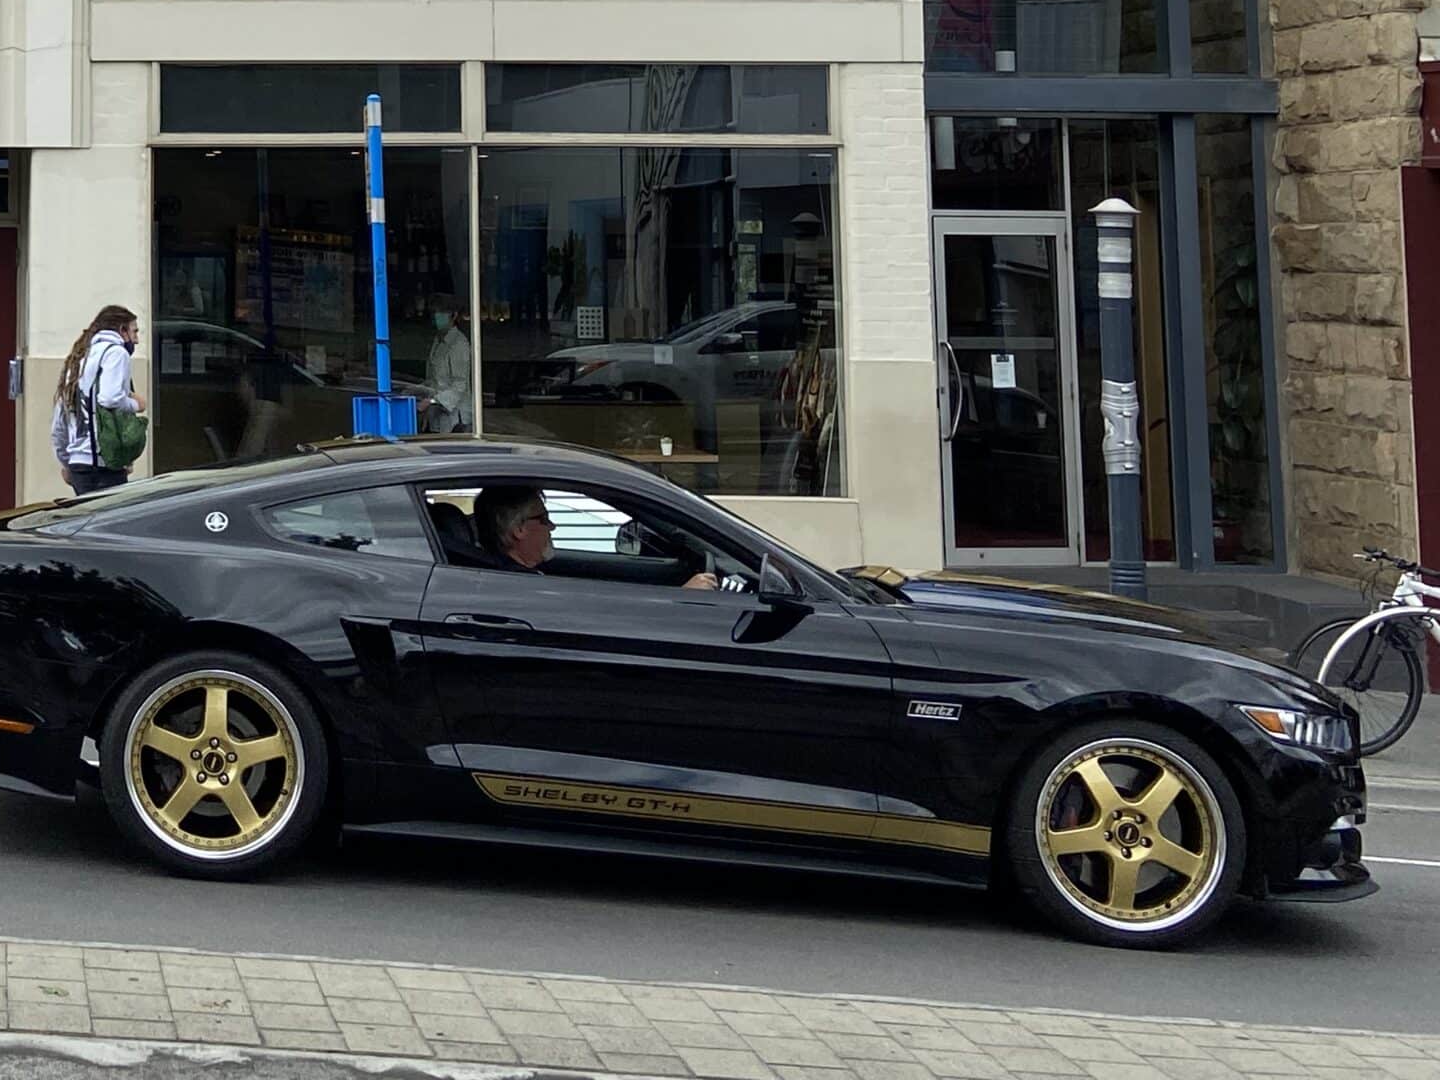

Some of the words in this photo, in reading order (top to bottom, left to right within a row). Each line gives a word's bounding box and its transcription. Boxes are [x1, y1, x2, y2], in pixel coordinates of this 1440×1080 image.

[914, 703, 955, 717] Hertz
[503, 784, 618, 806] SHELBY
[626, 796, 691, 814] GT-H
